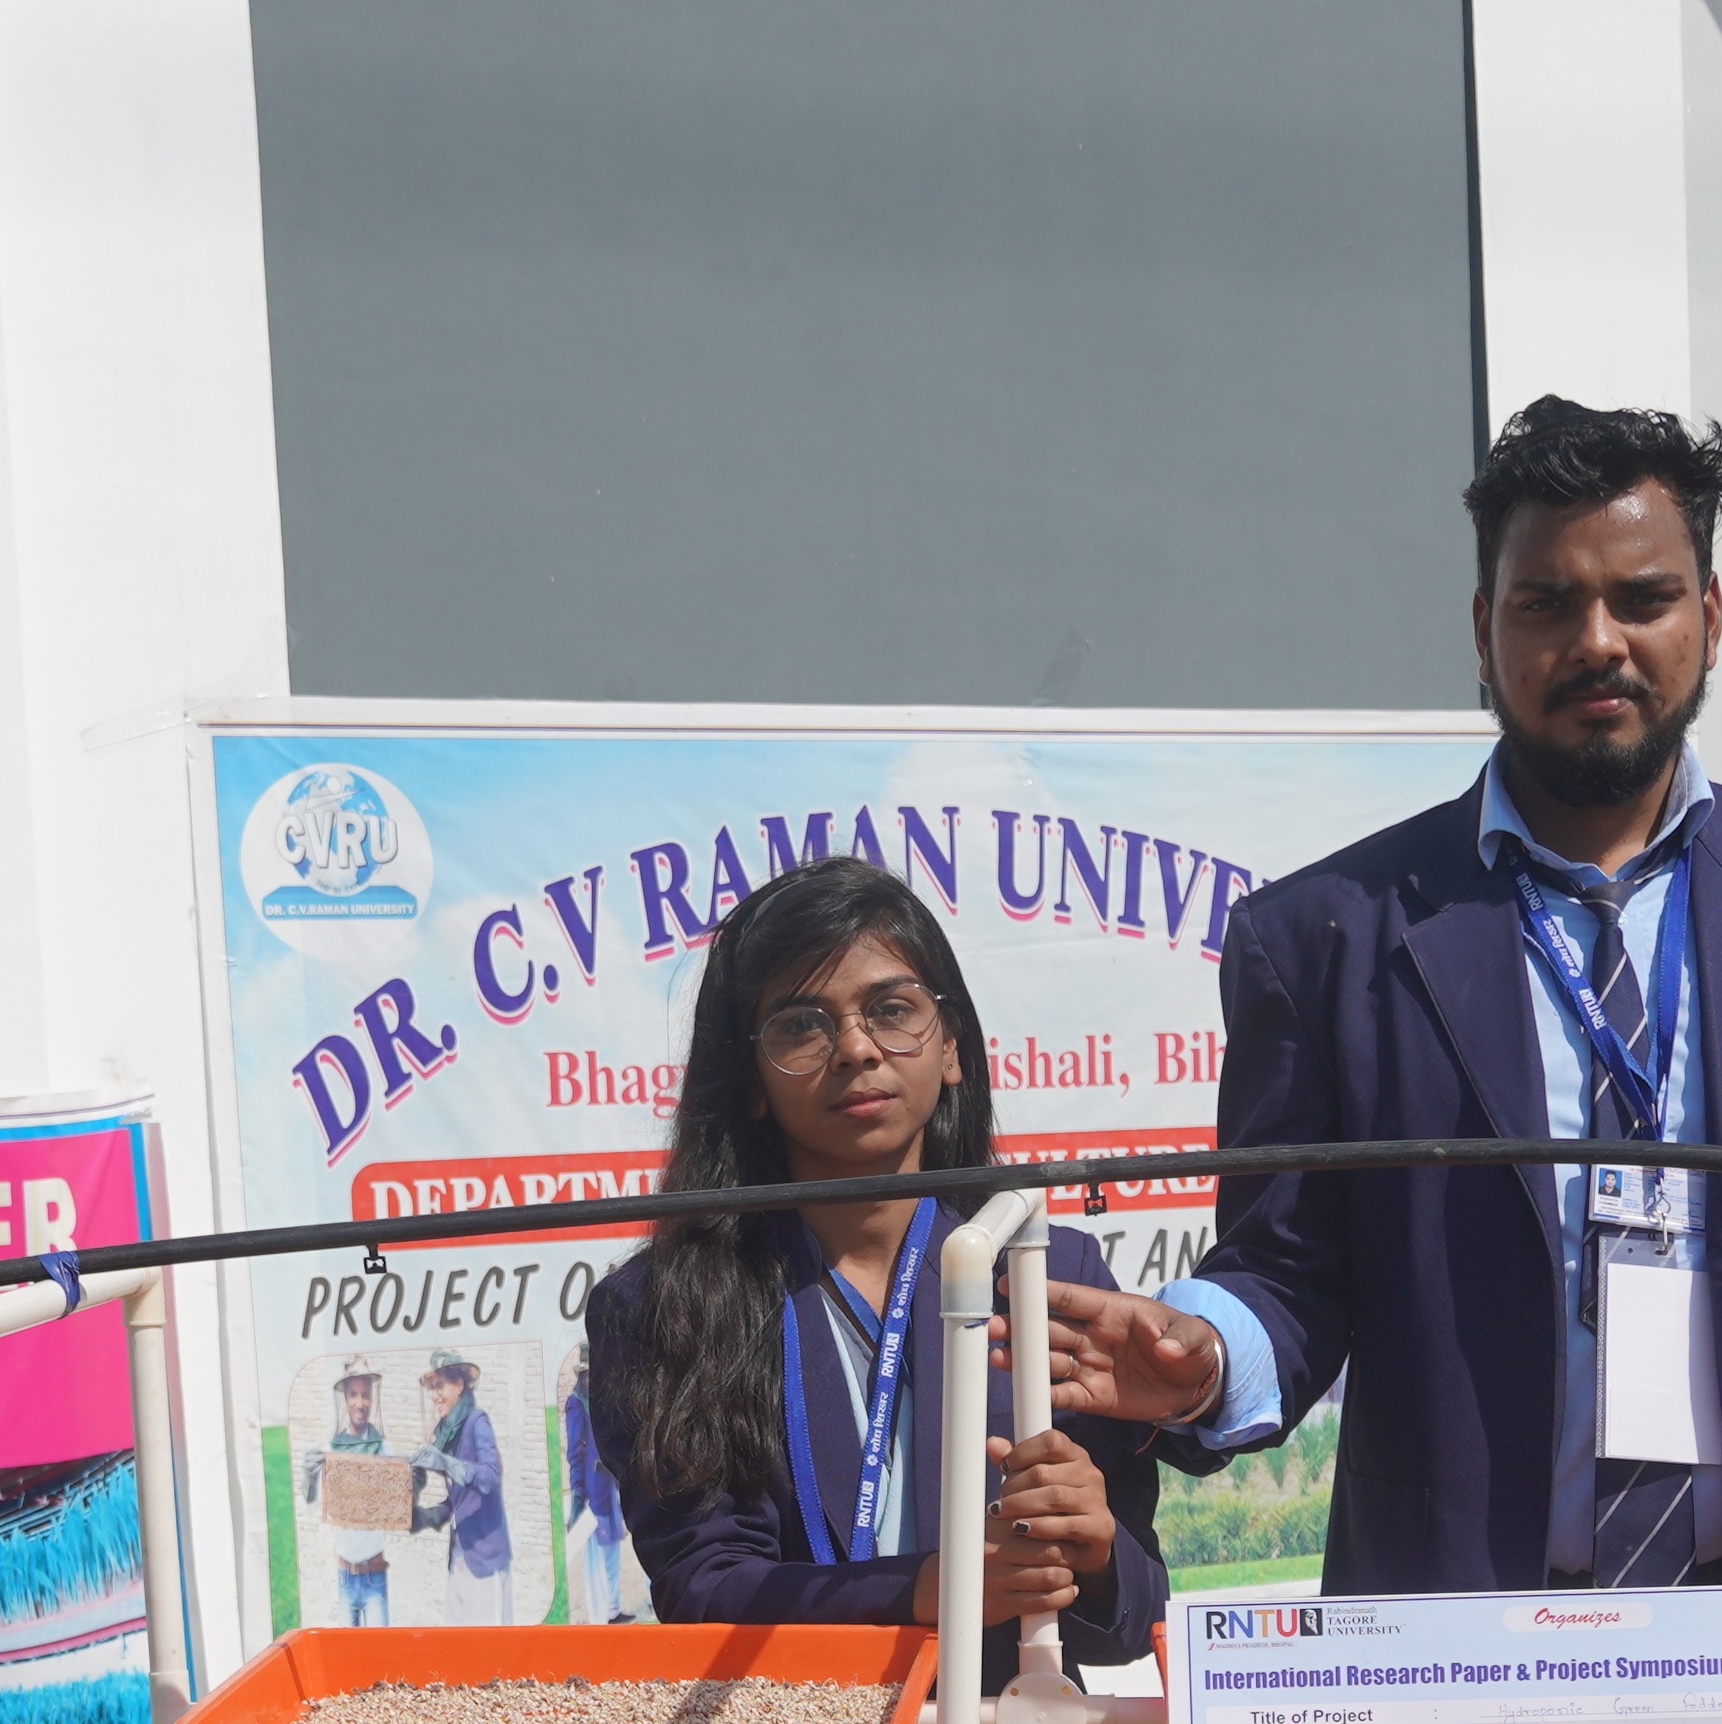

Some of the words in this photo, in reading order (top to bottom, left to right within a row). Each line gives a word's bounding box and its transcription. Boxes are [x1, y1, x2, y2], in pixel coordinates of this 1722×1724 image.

[275, 811, 398, 869] CVRU
[266, 904, 285, 916] DR.
[351, 904, 415, 915] UNIVERSITY
[292, 977, 459, 1168] DR.
[991, 808, 1262, 963] UNIVE
[1582, 993, 1607, 1031] RNTU
[544, 1050, 682, 1118] Bhag
[988, 1034, 1131, 1099] ishali,
[1153, 1030, 1227, 1084] Bih
[370, 1168, 662, 1222] DEPARTM
[301, 1263, 540, 1341] PROJECT
[1137, 1226, 1209, 1287] AN
[881, 1340, 900, 1378] RNTU
[857, 1490, 875, 1528] RNTU
[1205, 1607, 1298, 1640] RNTU
[1326, 1615, 1377, 1626] TAGORE
[1327, 1624, 1403, 1637] UNIVERSITY
[1533, 1607, 1623, 1630] Organizes
[1205, 1666, 1341, 1691] International
[1346, 1662, 1446, 1687] Research
[1451, 1661, 1512, 1686] Paper
[1516, 1663, 1532, 1682] &
[1536, 1658, 1612, 1682] Project
[1291, 1709, 1308, 1724] of
